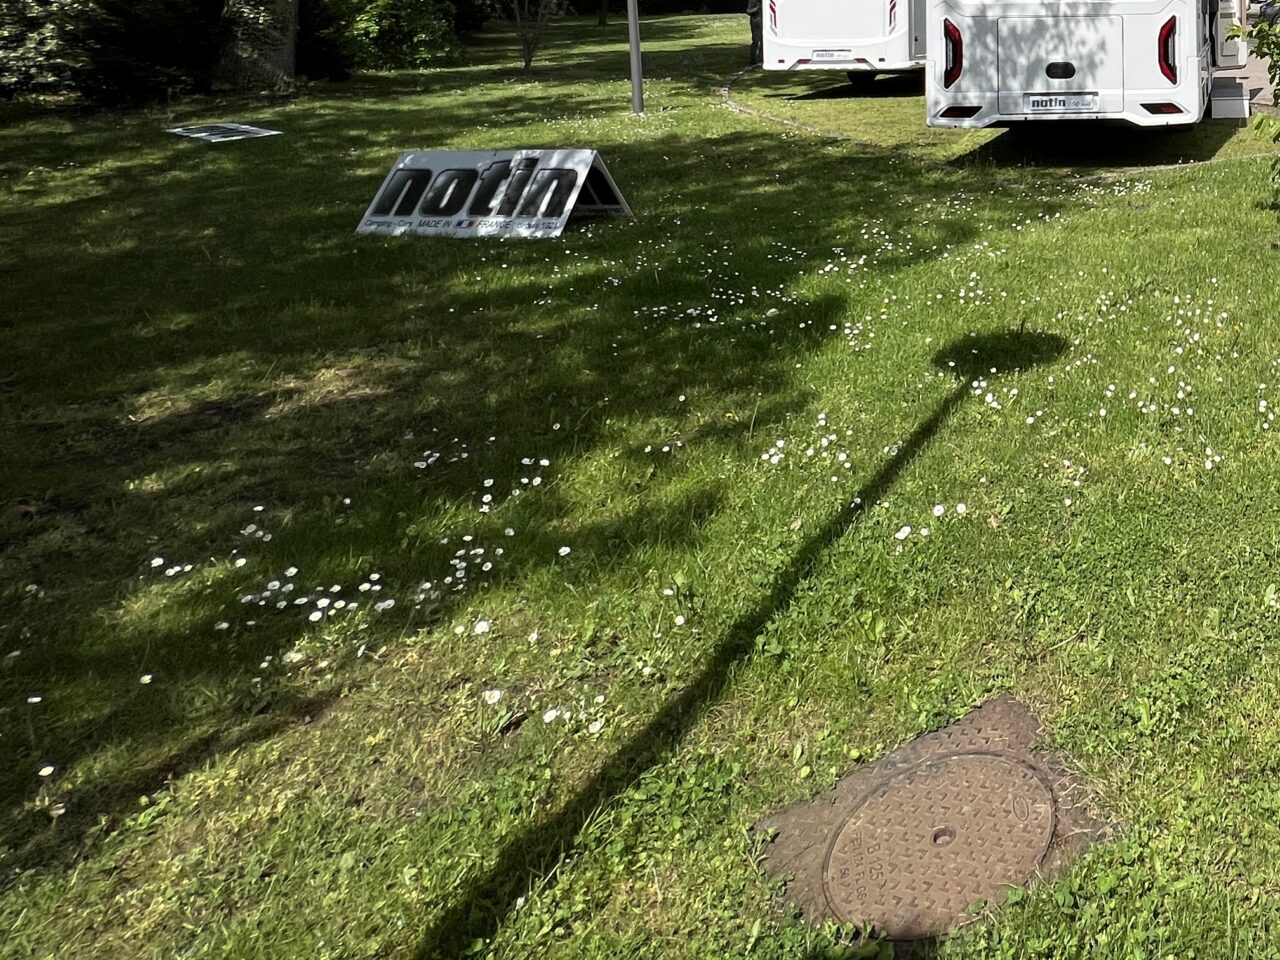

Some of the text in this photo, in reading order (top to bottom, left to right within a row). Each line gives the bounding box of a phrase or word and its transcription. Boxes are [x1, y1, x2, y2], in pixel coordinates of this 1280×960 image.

[1032, 98, 1066, 108] notin
[370, 158, 578, 217] notin
[476, 220, 512, 228] FRANCE
[867, 843, 883, 880] B 125
